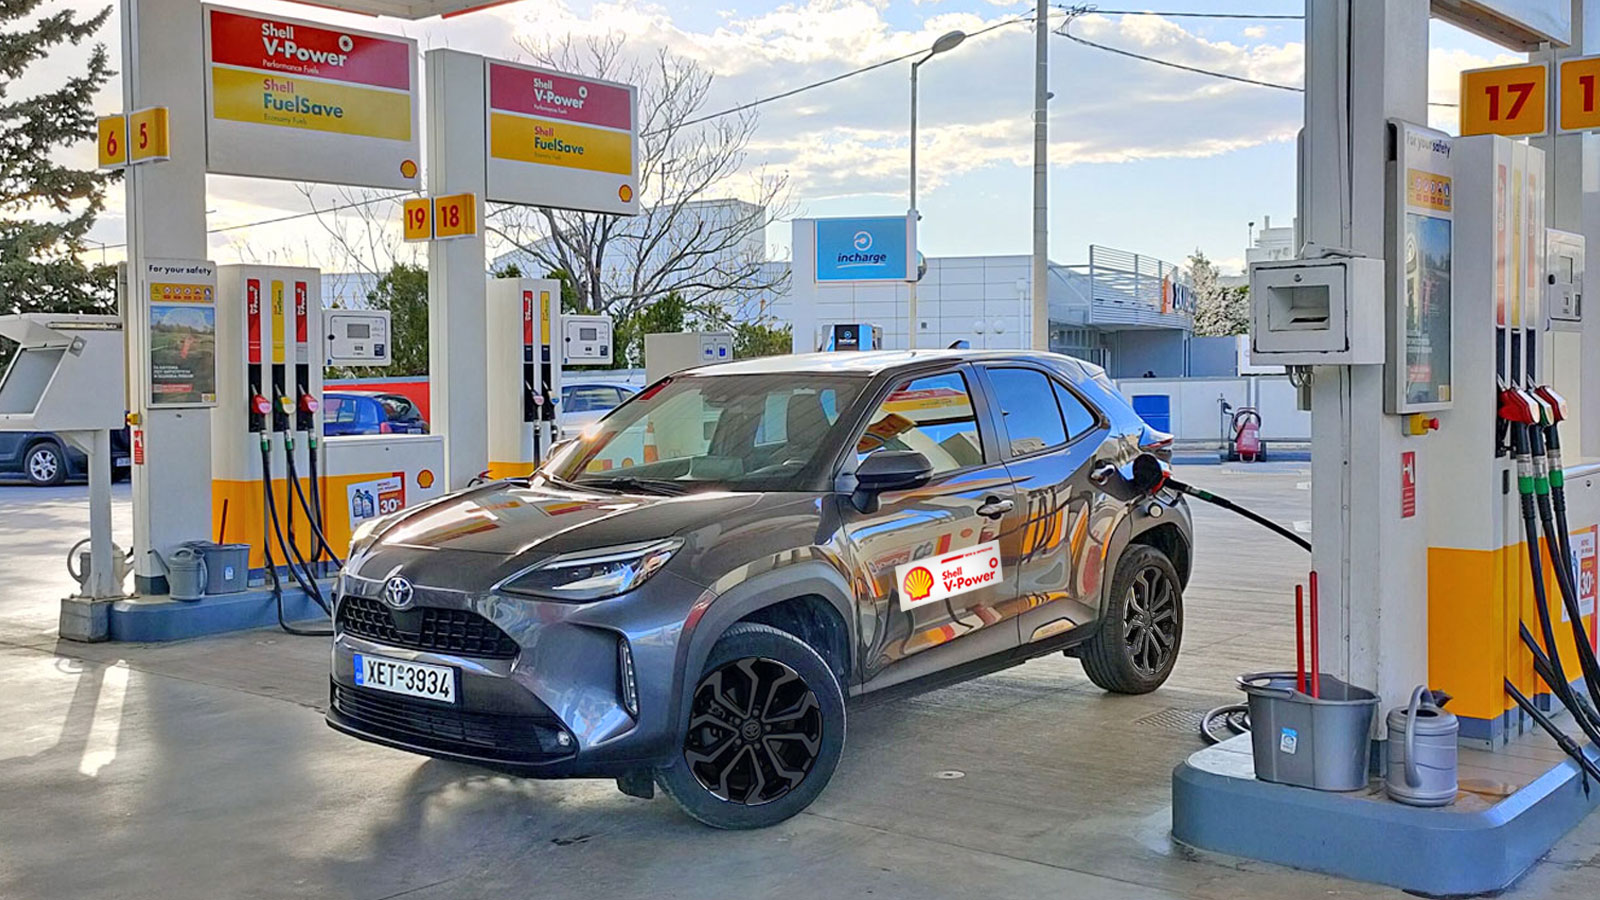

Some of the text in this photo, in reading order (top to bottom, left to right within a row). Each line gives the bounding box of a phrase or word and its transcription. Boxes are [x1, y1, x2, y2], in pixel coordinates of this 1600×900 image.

[262, 23, 294, 39] Shell
[262, 37, 347, 67] V-Power
[263, 59, 319, 74] Performance Fuels
[263, 79, 294, 93] Shell
[534, 78, 553, 90] Shell
[1579, 75, 1597, 112] 1
[263, 93, 343, 118] FuelSave
[534, 89, 584, 109] V-Power
[1485, 82, 1536, 121] 17
[140, 122, 148, 149] 5
[535, 126, 554, 137] Shell
[107, 130, 117, 157] 6
[535, 137, 584, 155] FuelSave
[1432, 140, 1451, 158] safety
[408, 208, 425, 230] 19
[441, 205, 459, 228] 18
[838, 253, 887, 264] incharge
[149, 264, 212, 276] For your safety
[942, 566, 963, 580] Shell
[943, 571, 995, 592] V-Power
